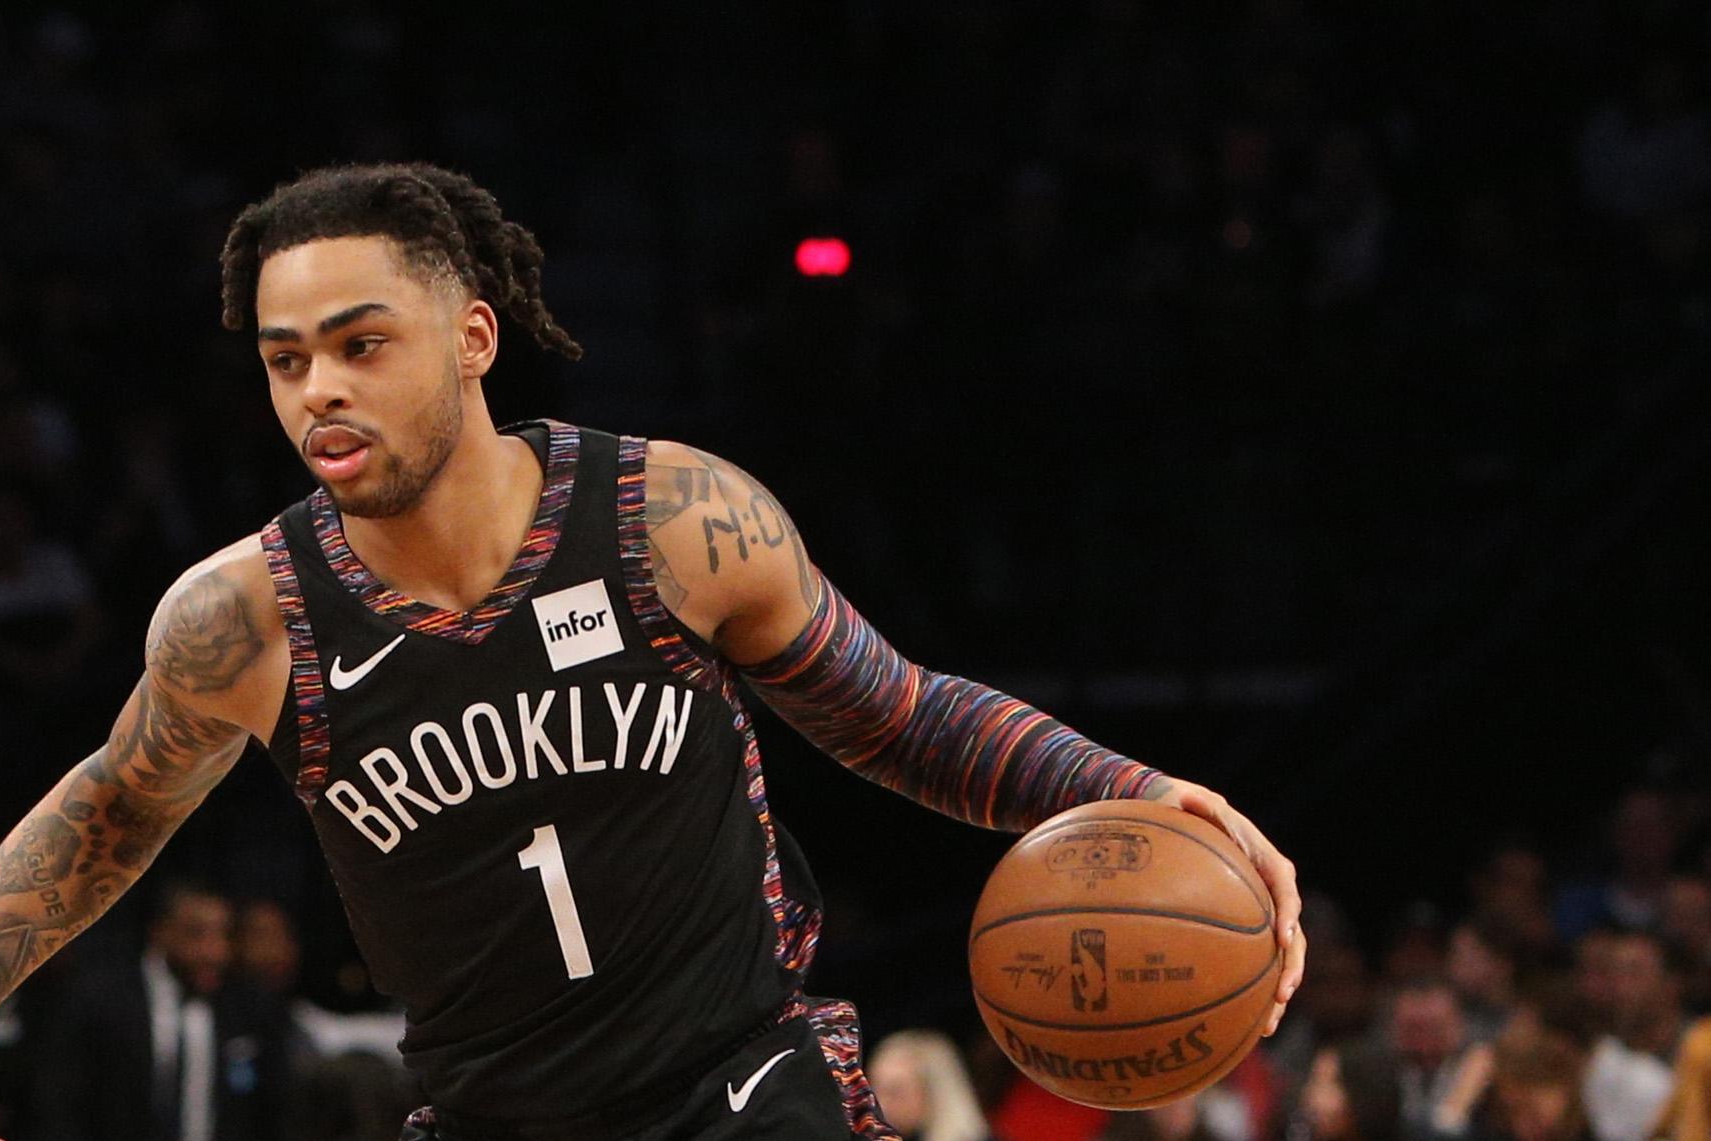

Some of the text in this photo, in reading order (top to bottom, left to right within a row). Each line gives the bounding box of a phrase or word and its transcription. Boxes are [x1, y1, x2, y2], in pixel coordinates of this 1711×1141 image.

[545, 609, 607, 643] infor
[324, 682, 694, 854] BROOKLYN
[517, 823, 595, 980] 1
[1002, 1022, 1213, 1081] SPALDING
